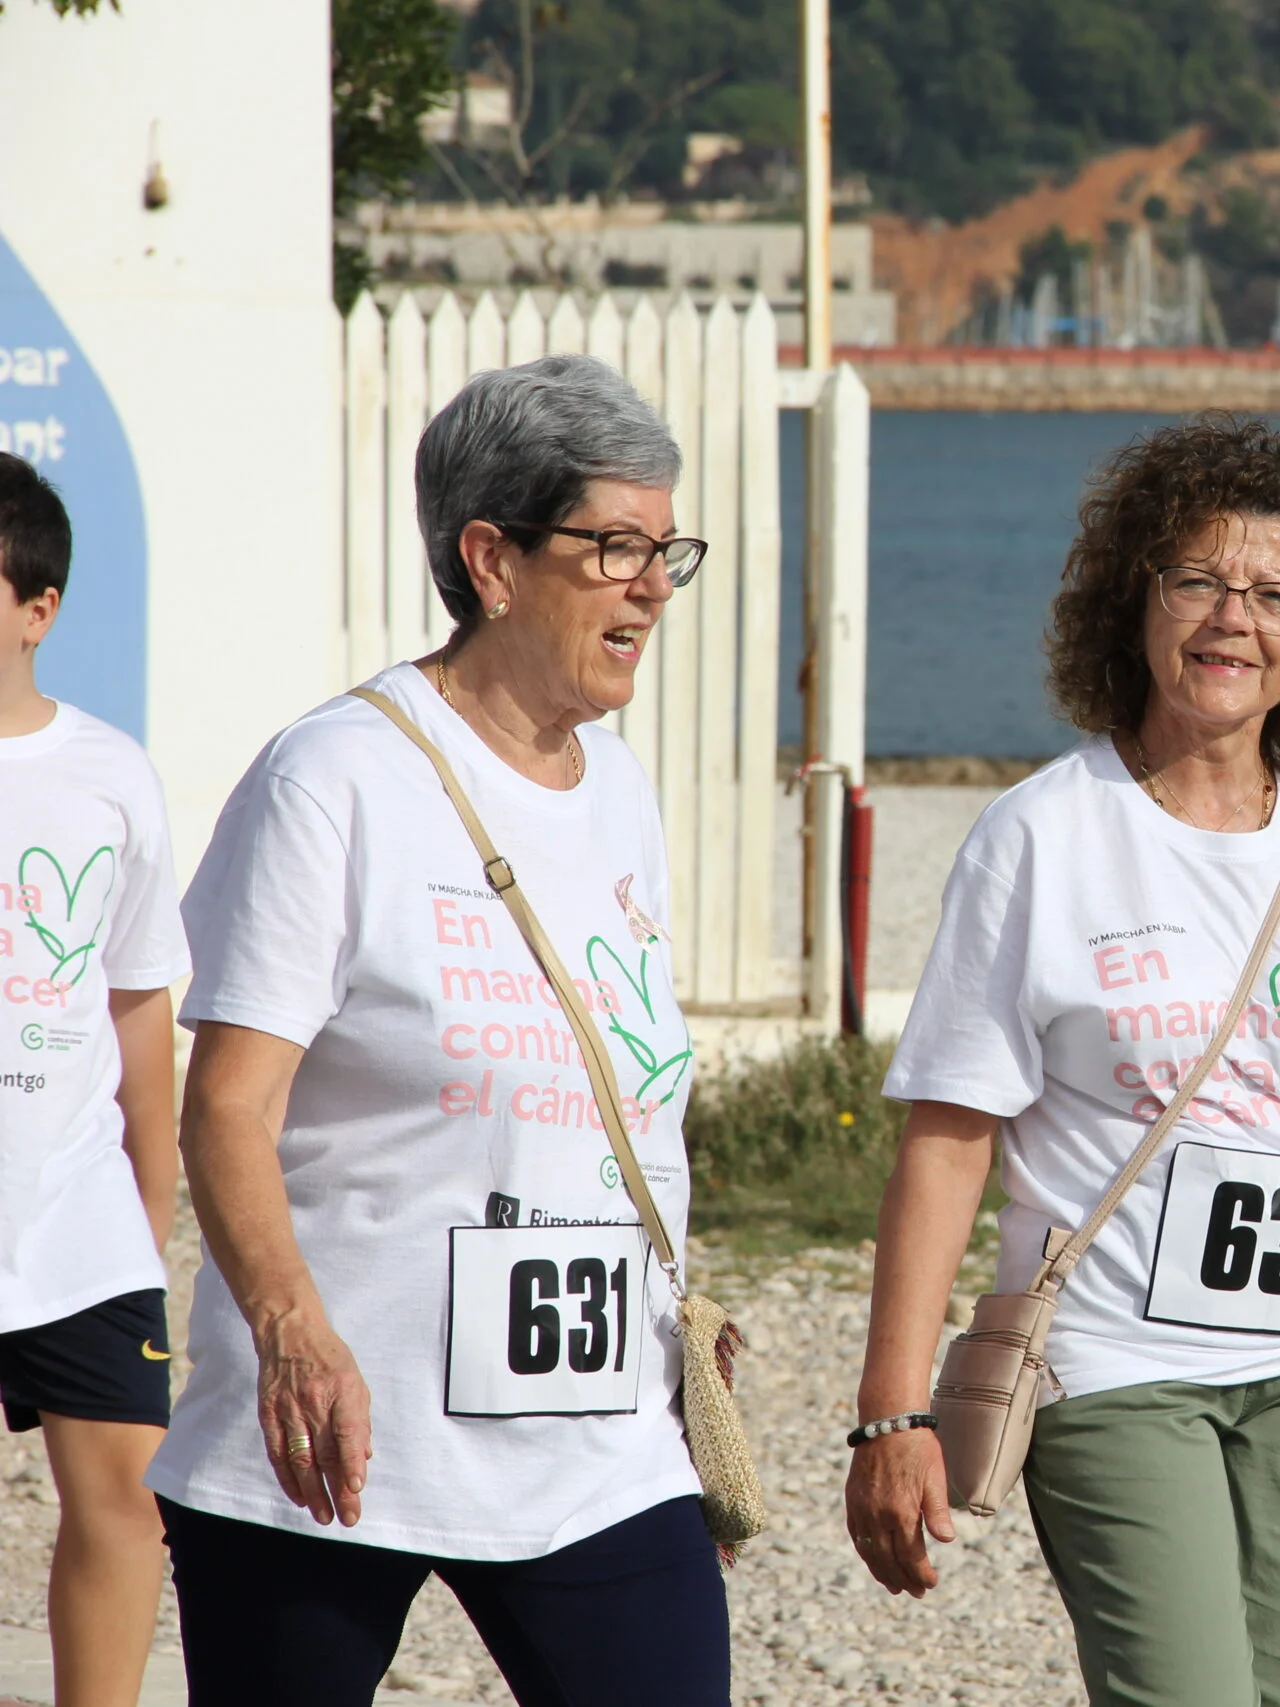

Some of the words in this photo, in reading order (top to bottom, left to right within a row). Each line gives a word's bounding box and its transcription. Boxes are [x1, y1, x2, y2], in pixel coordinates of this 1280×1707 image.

[438, 885, 472, 897] MARCHA
[473, 890, 483, 899] EN
[432, 898, 492, 949] En
[1088, 937, 1098, 947] IV
[1100, 929, 1145, 943] MARCHA
[1145, 924, 1161, 934] EN
[1093, 945, 1170, 992] En
[441, 1017, 587, 1069] contr
[438, 1069, 494, 1117] el
[508, 1258, 628, 1375] 631
